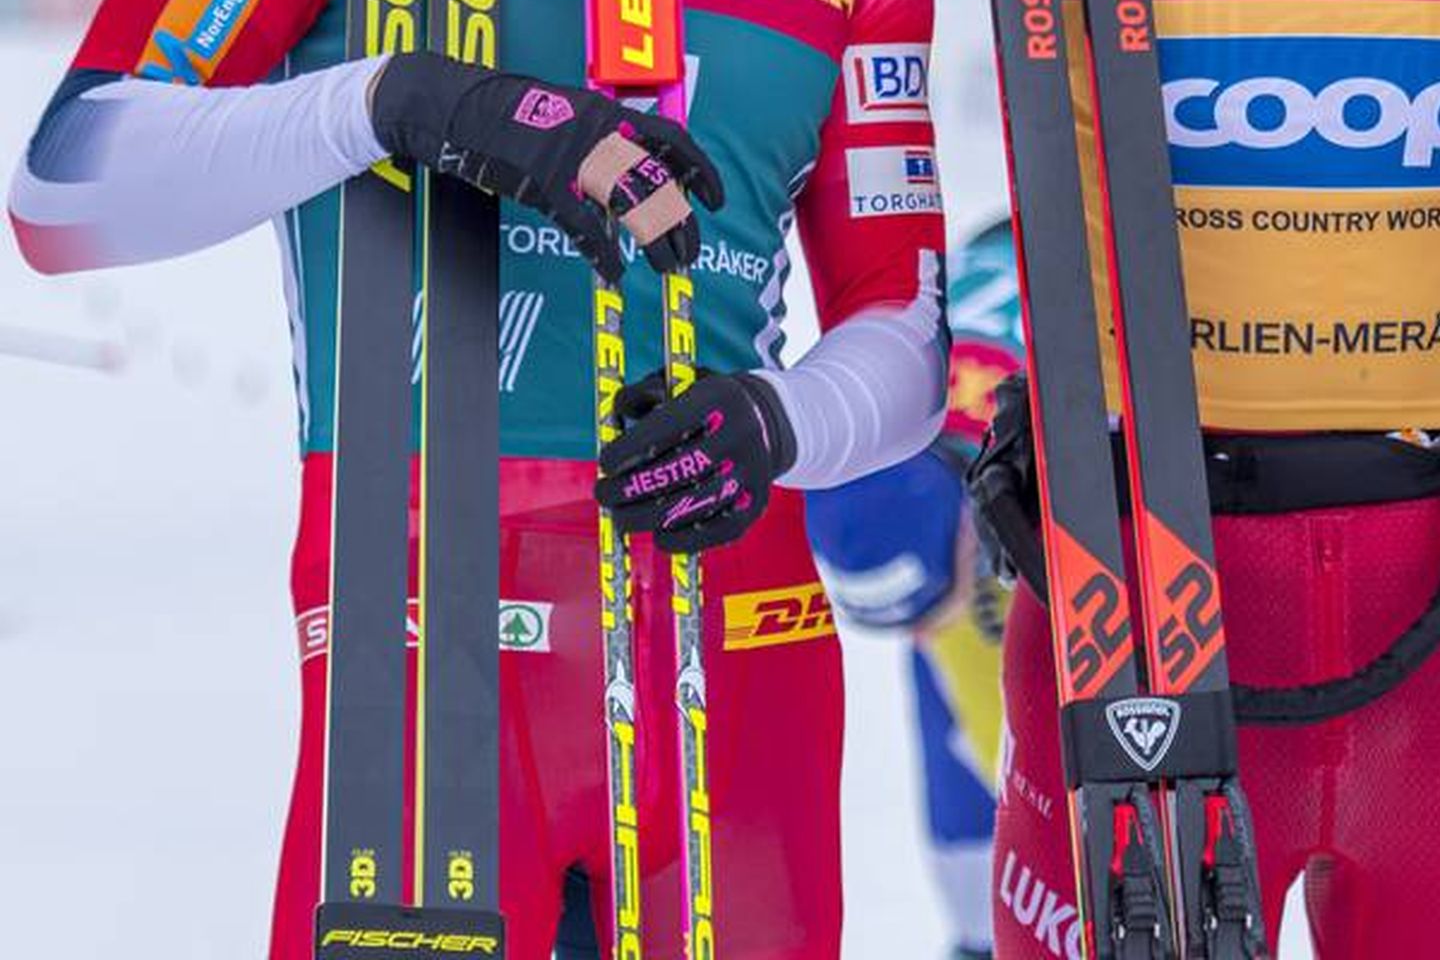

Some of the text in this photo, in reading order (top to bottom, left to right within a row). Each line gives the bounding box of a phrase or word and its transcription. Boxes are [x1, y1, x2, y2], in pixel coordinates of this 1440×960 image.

[1174, 207, 1243, 230] ROSS
[1252, 209, 1384, 234] COUNTRY
[755, 592, 833, 636] DH
[349, 856, 376, 899] 3D
[447, 857, 475, 900] 3D
[1000, 849, 1082, 960] LUK
[321, 928, 498, 955] FISCHER
